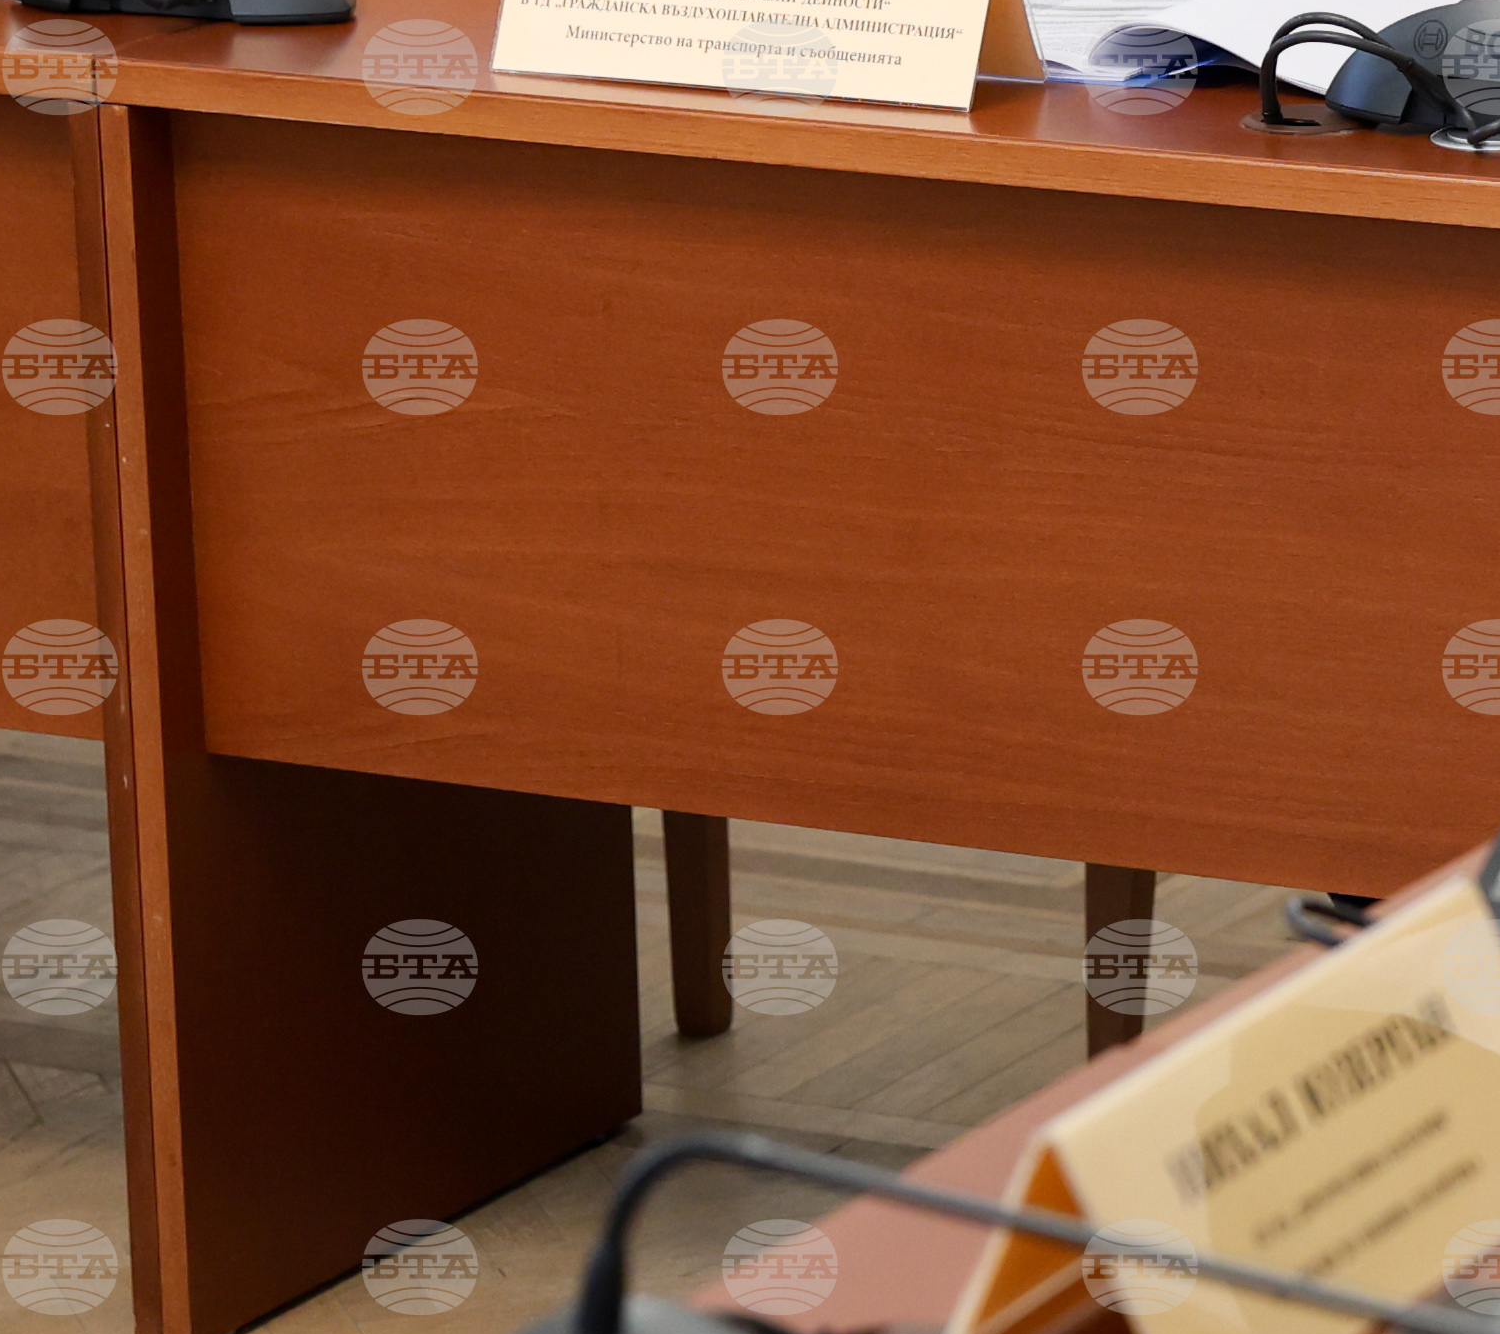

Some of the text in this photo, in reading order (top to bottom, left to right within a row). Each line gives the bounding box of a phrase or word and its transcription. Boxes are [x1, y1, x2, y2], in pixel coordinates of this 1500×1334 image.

[566, 24, 902, 65] Министерство на транспорта и съобщенията
